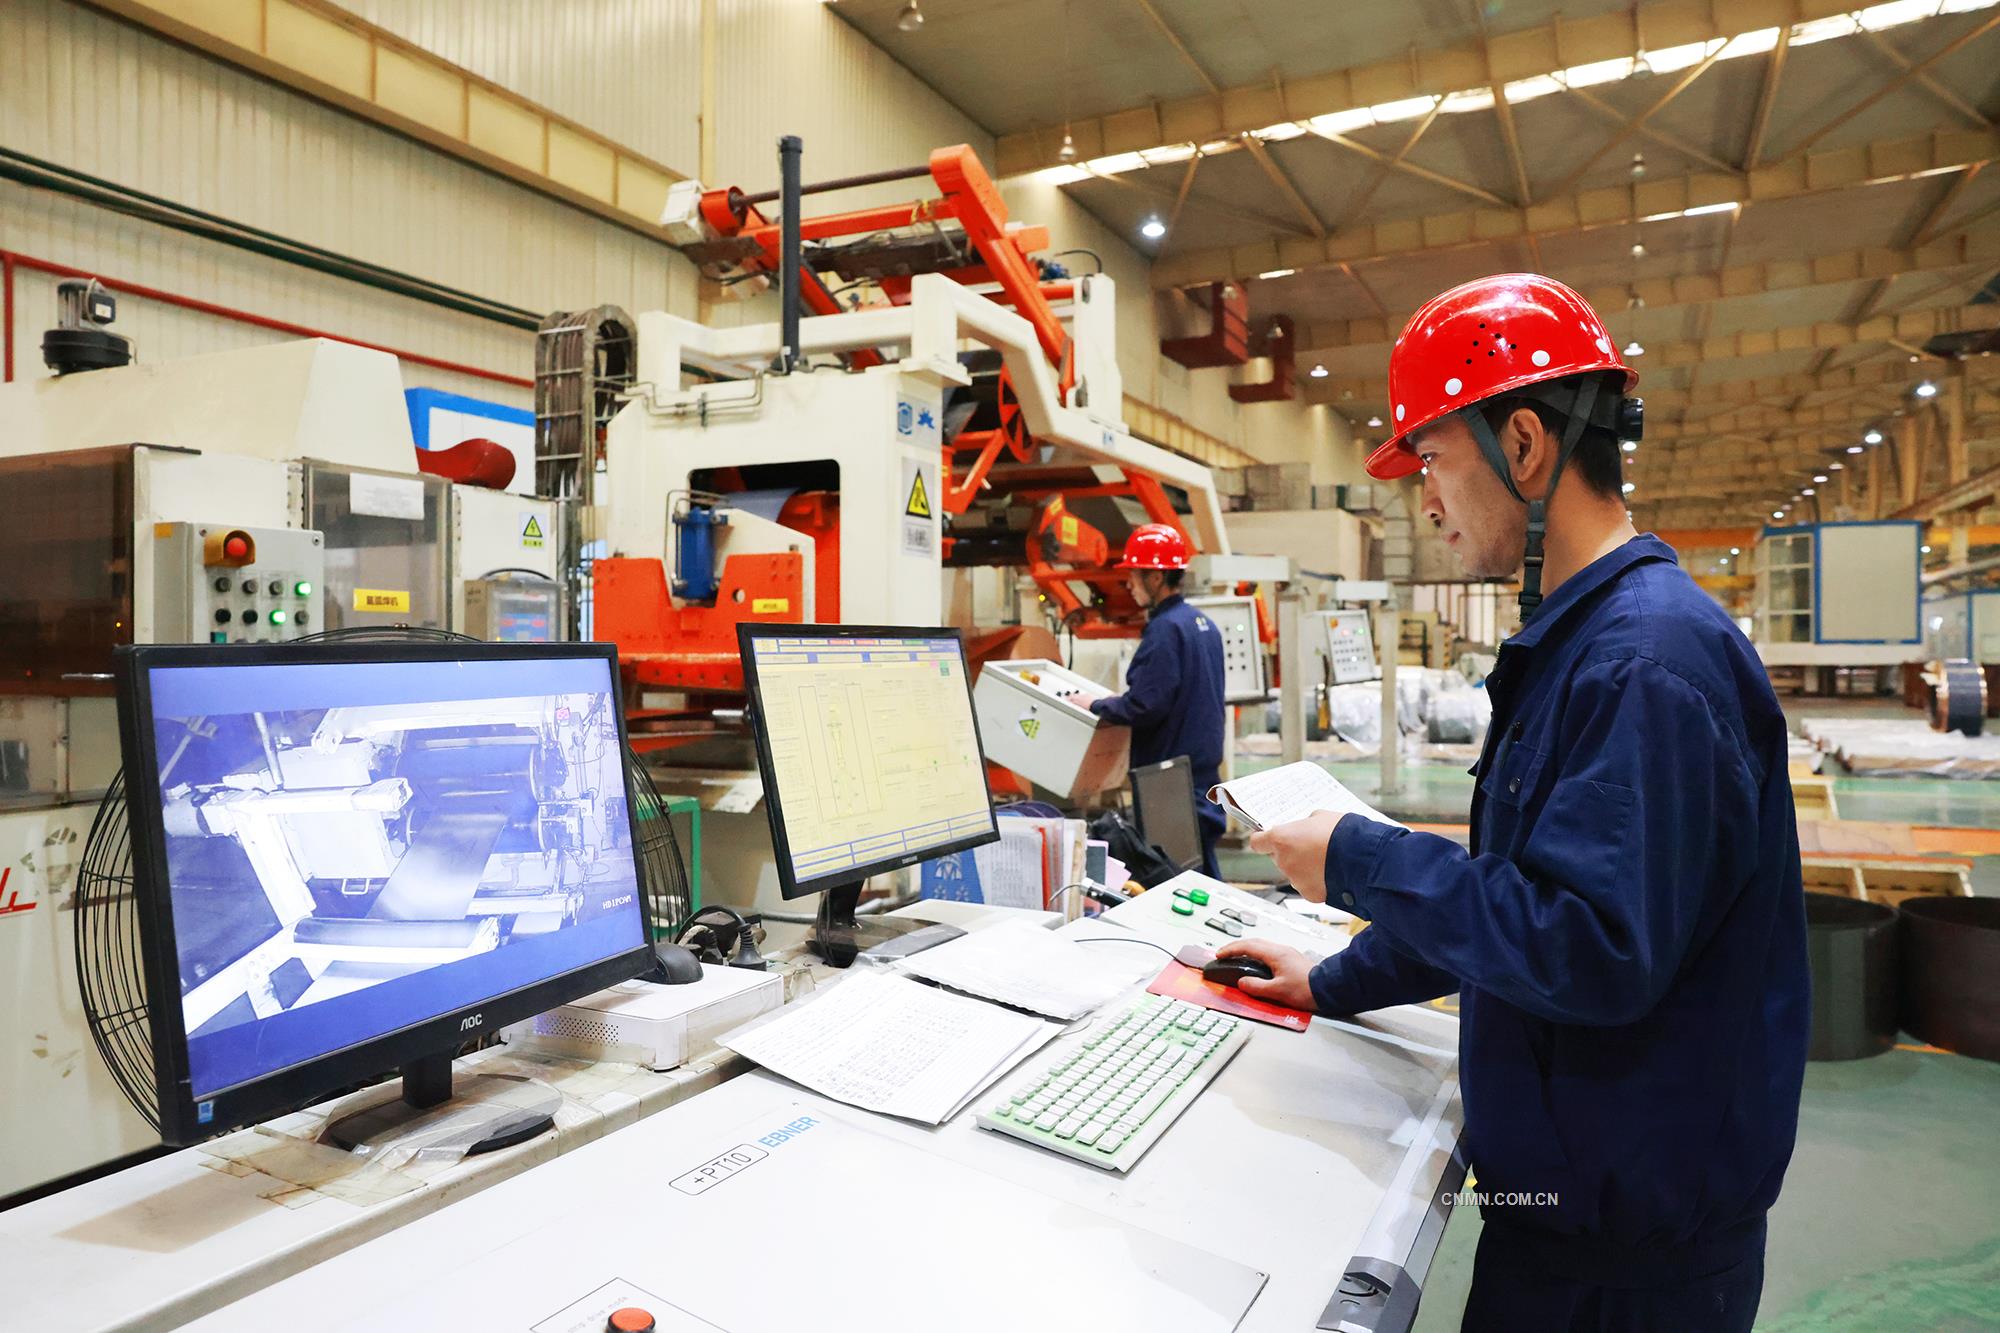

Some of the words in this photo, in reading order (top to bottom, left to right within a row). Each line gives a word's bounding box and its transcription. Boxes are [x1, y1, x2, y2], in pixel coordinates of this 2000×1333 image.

[460, 1013, 483, 1031] AOC
[693, 1151, 752, 1184] +PT10
[757, 1115, 821, 1149] EBNER
